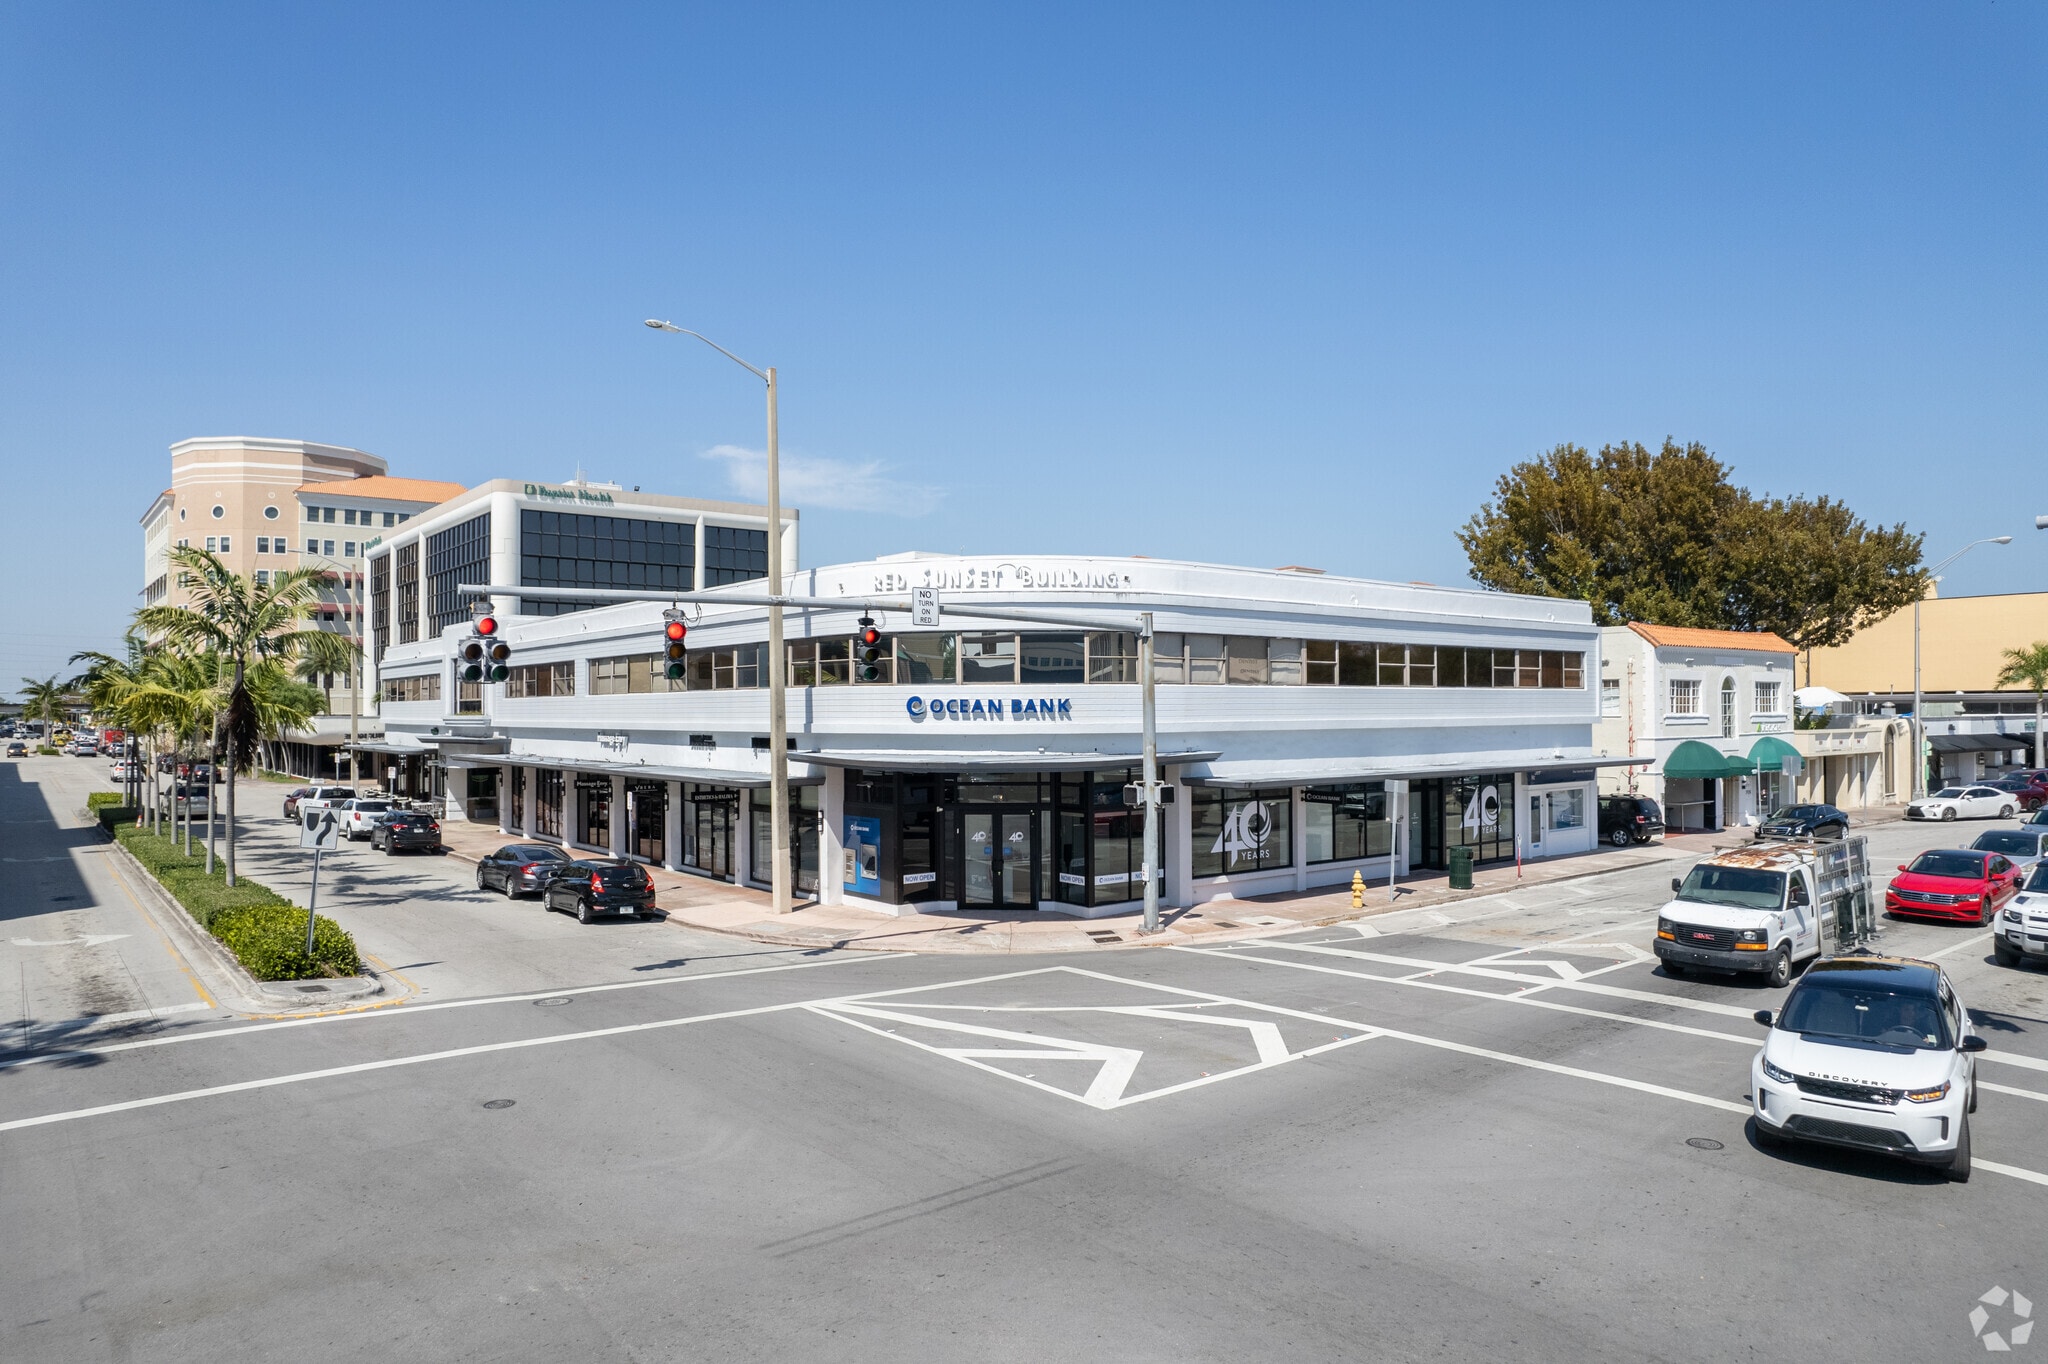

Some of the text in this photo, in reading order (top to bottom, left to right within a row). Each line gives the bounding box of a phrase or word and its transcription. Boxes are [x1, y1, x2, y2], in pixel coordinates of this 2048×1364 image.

[873, 566, 1120, 592] RED SUNSET BUILDING
[919, 590, 932, 599] NO
[920, 616, 932, 624] RED
[930, 698, 1073, 714] OCEAN BANK
[1482, 825, 1502, 833] YEARS
[1241, 849, 1270, 861] YEARS
[1072, 876, 1084, 884] OPEN
[1693, 932, 1715, 941] GMC
[1808, 1071, 1888, 1086] DISCOVERY
